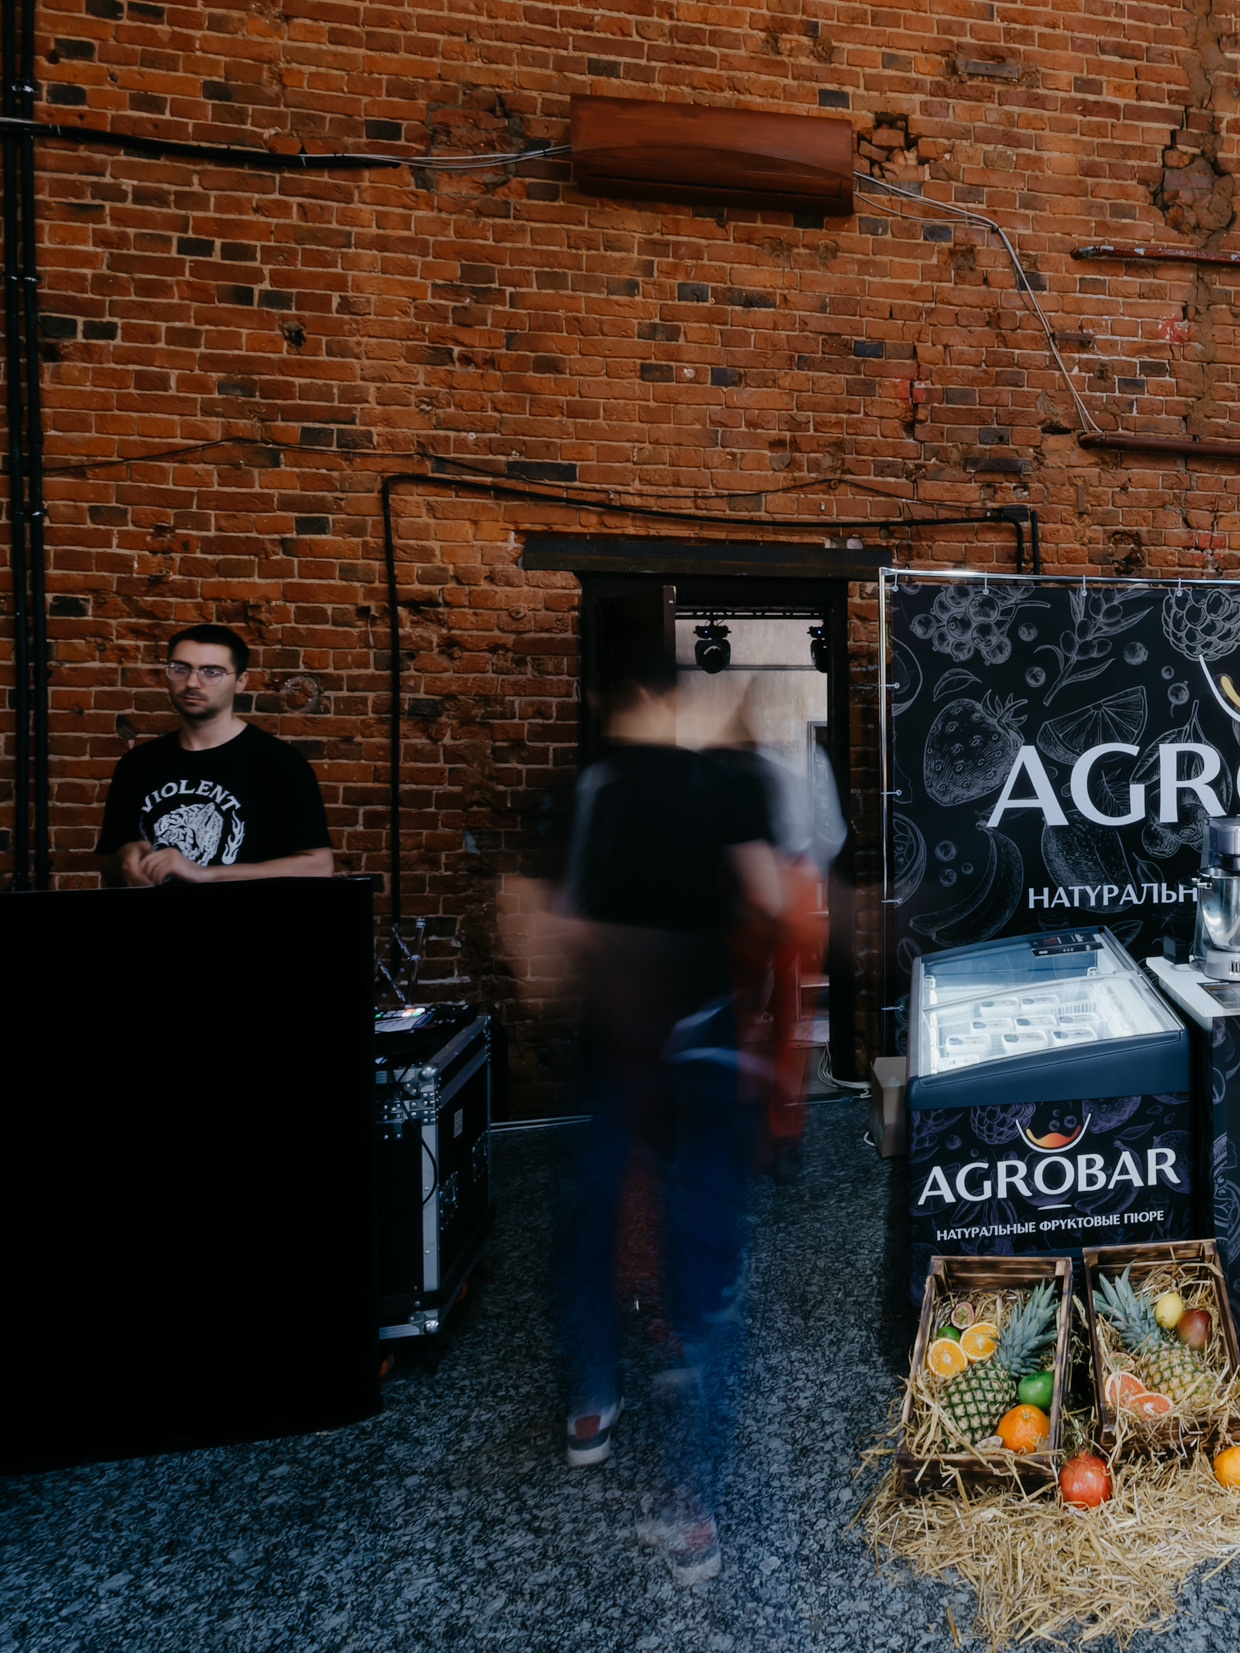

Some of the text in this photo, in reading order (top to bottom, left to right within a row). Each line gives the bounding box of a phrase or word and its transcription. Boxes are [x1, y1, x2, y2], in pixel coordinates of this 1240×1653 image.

[141, 779, 241, 813] VIOLENT
[1027, 881, 1199, 909] НАТУРАЛЬН
[917, 1147, 1181, 1205] AGROBAR
[936, 1210, 1164, 1241] НАТУРАЛЬНЫЕ ФРУКТОВЫЕ ПЮРЕ
